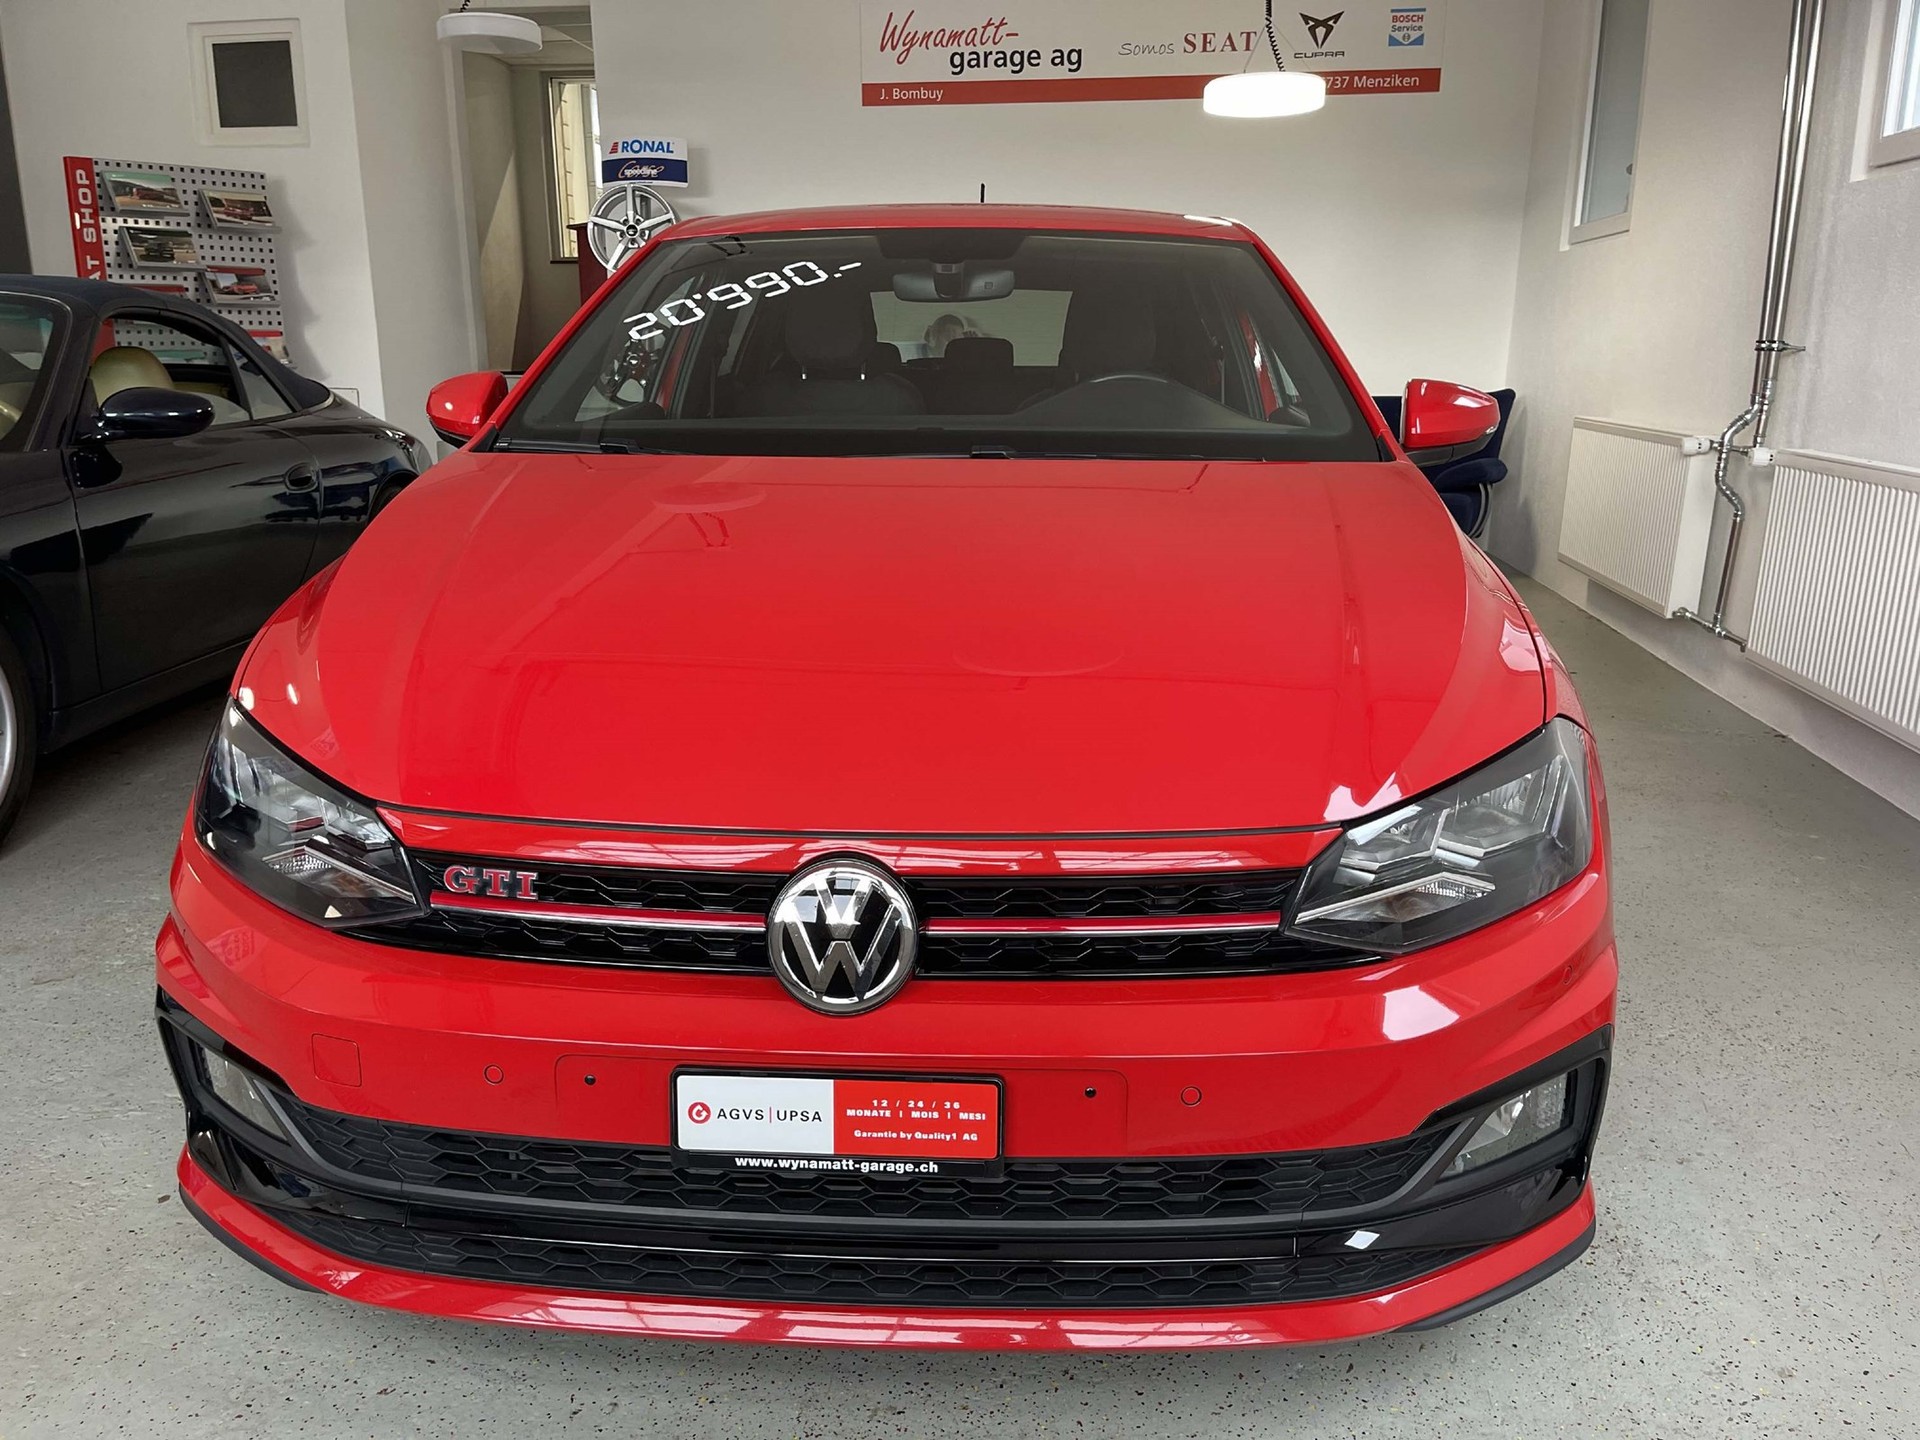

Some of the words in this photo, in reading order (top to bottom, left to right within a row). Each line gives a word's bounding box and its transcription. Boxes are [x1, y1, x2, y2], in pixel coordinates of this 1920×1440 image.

[1391, 14, 1424, 23] BOSCH
[880, 10, 1019, 65] Wynamatt-
[1118, 42, 1176, 56] Somos
[1183, 31, 1257, 54] SEAT
[949, 48, 1042, 76] garage
[1050, 47, 1082, 73] ag
[1294, 51, 1345, 59] CUPRA
[1323, 76, 1350, 89] 737
[1353, 74, 1420, 88] Menziken
[880, 89, 889, 100] J.
[892, 87, 943, 102] Bombuy
[621, 139, 674, 154] RONAL
[76, 169, 97, 243] SHOP
[443, 865, 539, 900] GTI
[872, 1099, 888, 1107] 12
[908, 1100, 924, 1108] 24
[944, 1101, 960, 1110] 36
[717, 1108, 764, 1121] AGVS
[776, 1109, 823, 1123] UPSA
[846, 1109, 891, 1118] MONATE
[911, 1111, 939, 1119] MOIS
[959, 1112, 986, 1121] MESI
[853, 1130, 898, 1139] Garantie
[900, 1131, 912, 1140] by
[914, 1131, 957, 1142] Quality1
[962, 1133, 978, 1141] AG
[734, 1157, 939, 1174] www.wynamatt-garage.ch
